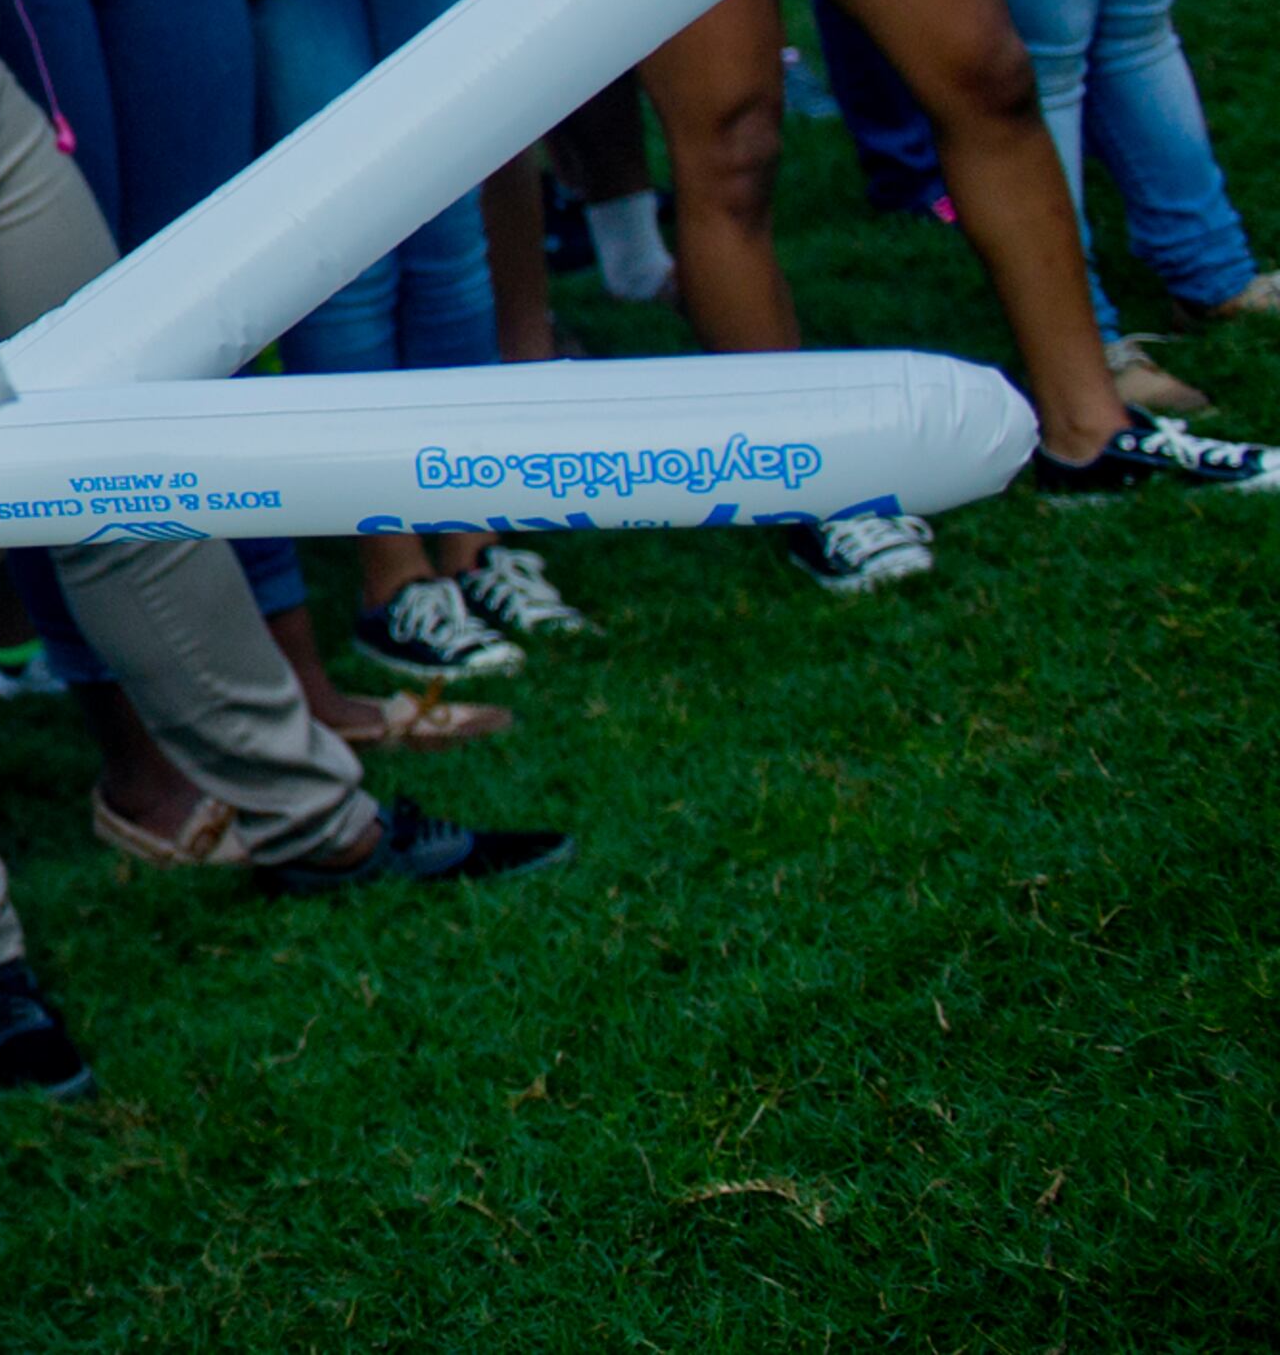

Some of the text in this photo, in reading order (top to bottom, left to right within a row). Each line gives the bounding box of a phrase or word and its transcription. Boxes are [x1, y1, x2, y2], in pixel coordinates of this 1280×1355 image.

[416, 433, 823, 498] dayforkids.org
[69, 472, 198, 494] OF AMERICA
[90, 494, 171, 515] GIRLS
[178, 493, 200, 511] &
[206, 490, 282, 511] BOYS
